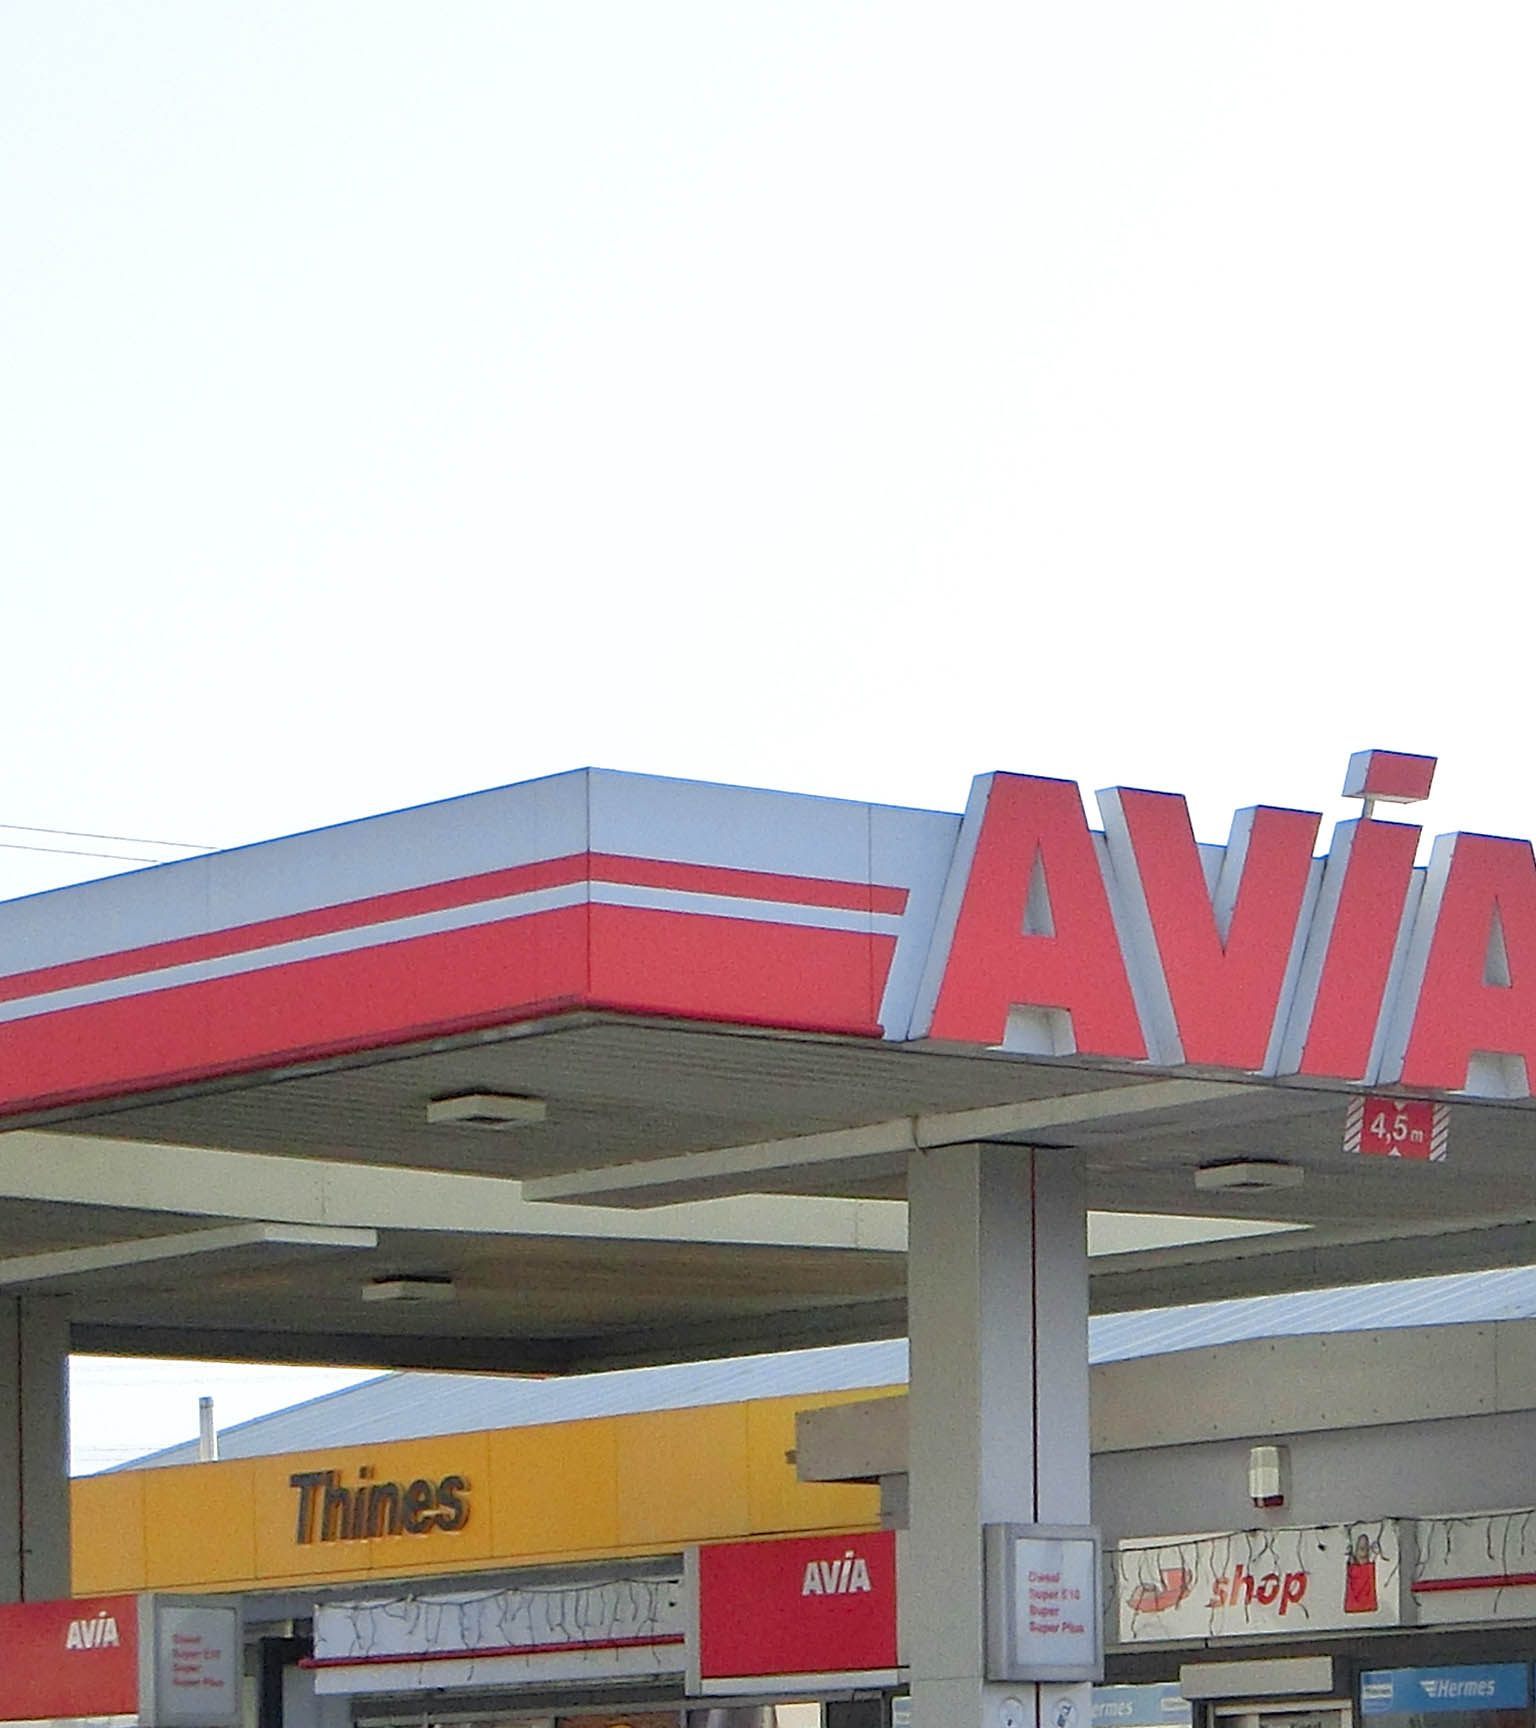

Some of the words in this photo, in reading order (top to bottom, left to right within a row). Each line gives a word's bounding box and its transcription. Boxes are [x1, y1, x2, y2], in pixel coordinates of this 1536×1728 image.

[1370, 1112, 1407, 1143] 4,5
[1410, 1129, 1424, 1143] m
[290, 1466, 470, 1545] Thines
[1210, 1564, 1310, 1616] shop
[1437, 1679, 1496, 1698] Hermes
